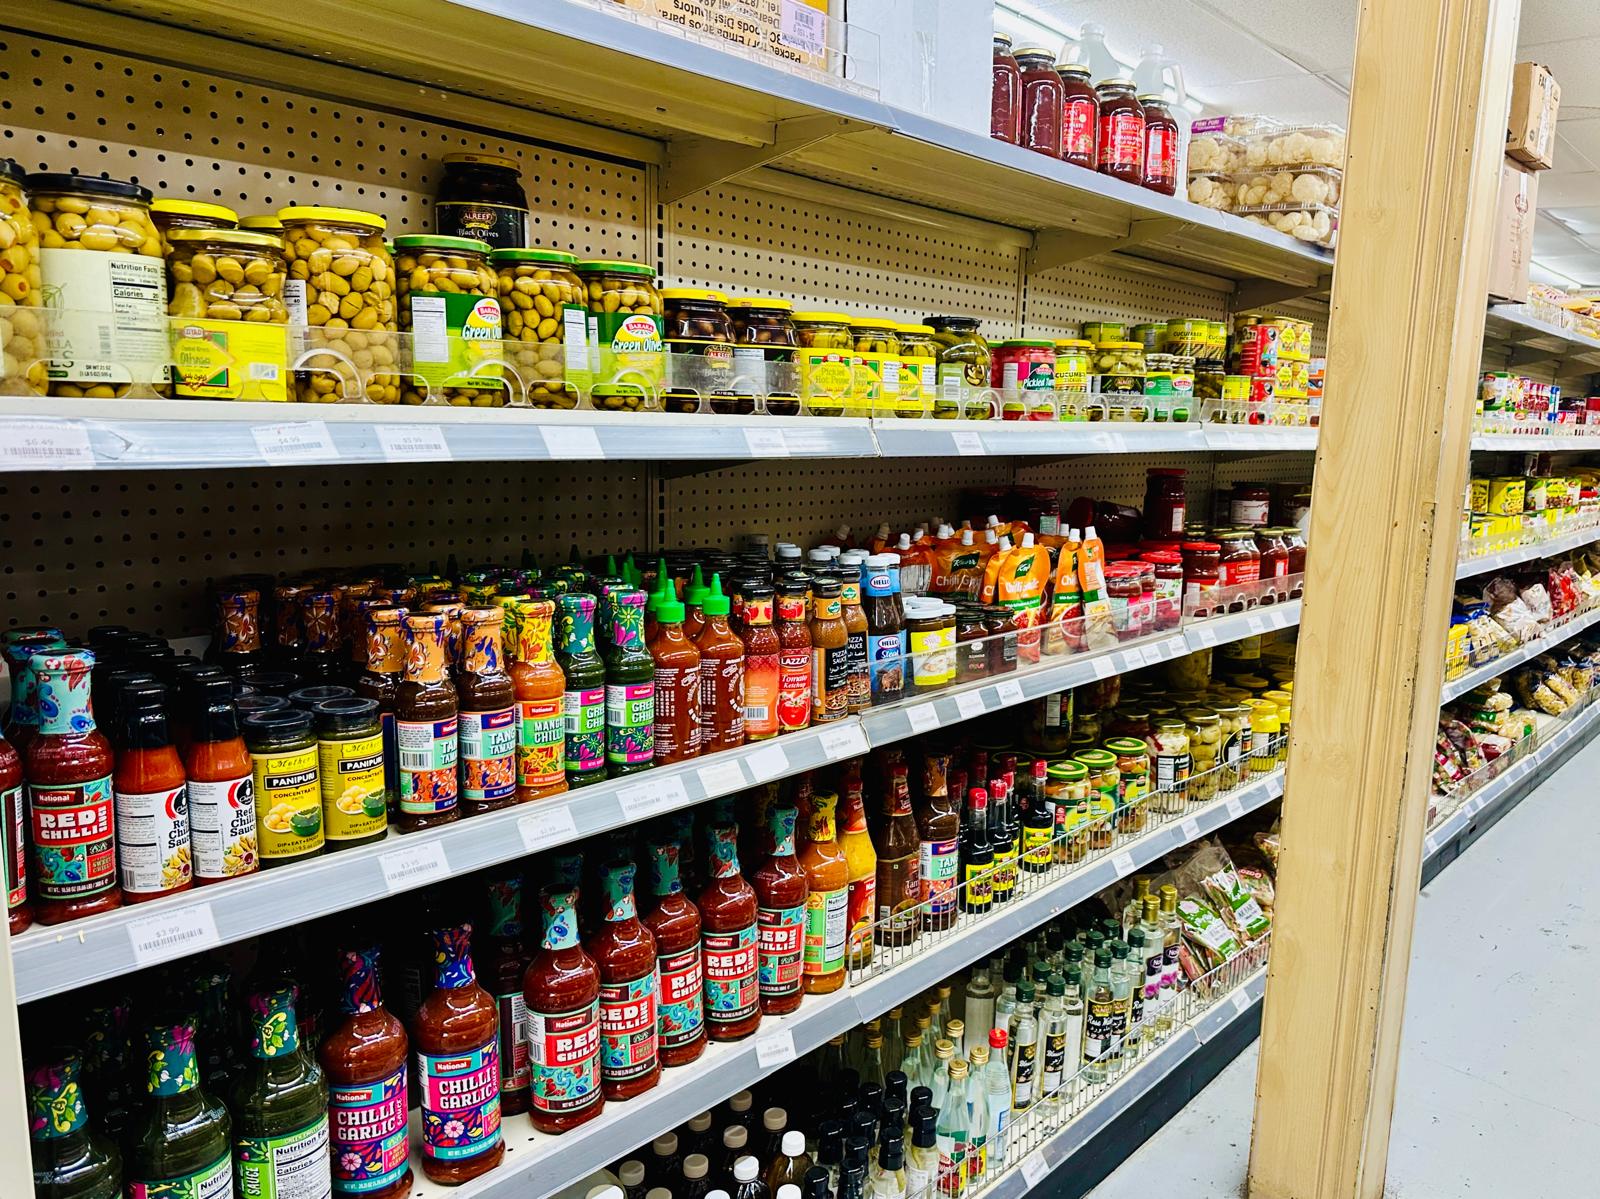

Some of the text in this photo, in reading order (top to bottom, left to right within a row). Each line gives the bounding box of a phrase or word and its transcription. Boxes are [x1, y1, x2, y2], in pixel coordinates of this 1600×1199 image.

[477, 229, 499, 238] Olives
[110, 262, 143, 272] Nutrition
[113, 288, 144, 298] Calories
[462, 324, 491, 340] Green
[628, 323, 654, 333] BARAKA
[612, 337, 662, 353] Green Olives
[1024, 378, 1043, 388] Pickled
[781, 656, 808, 665] LAZZAT
[782, 674, 808, 683] Tomato
[346, 755, 383, 771] PANIPURI
[272, 771, 315, 787] PANIPURI
[39, 793, 70, 802] National
[273, 786, 316, 799] CONCENTRATE
[39, 809, 96, 828] RED
[235, 807, 253, 819] Red
[41, 824, 98, 840] CHILLI
[291, 839, 303, 847] EAT
[707, 953, 747, 968] RED
[707, 963, 748, 977] CHILLI
[555, 1017, 583, 1029] National
[556, 1028, 599, 1053] RED
[436, 1061, 468, 1070] National
[438, 1067, 492, 1095] CHILLI
[336, 1093, 367, 1101] National
[439, 1087, 492, 1110] GARLIC
[337, 1100, 396, 1126] CHILLI
[338, 1117, 396, 1142] GARLIC
[275, 1137, 317, 1156] Nutrition
[276, 1160, 313, 1175] Calories
[246, 1165, 261, 1197] SAUCE
